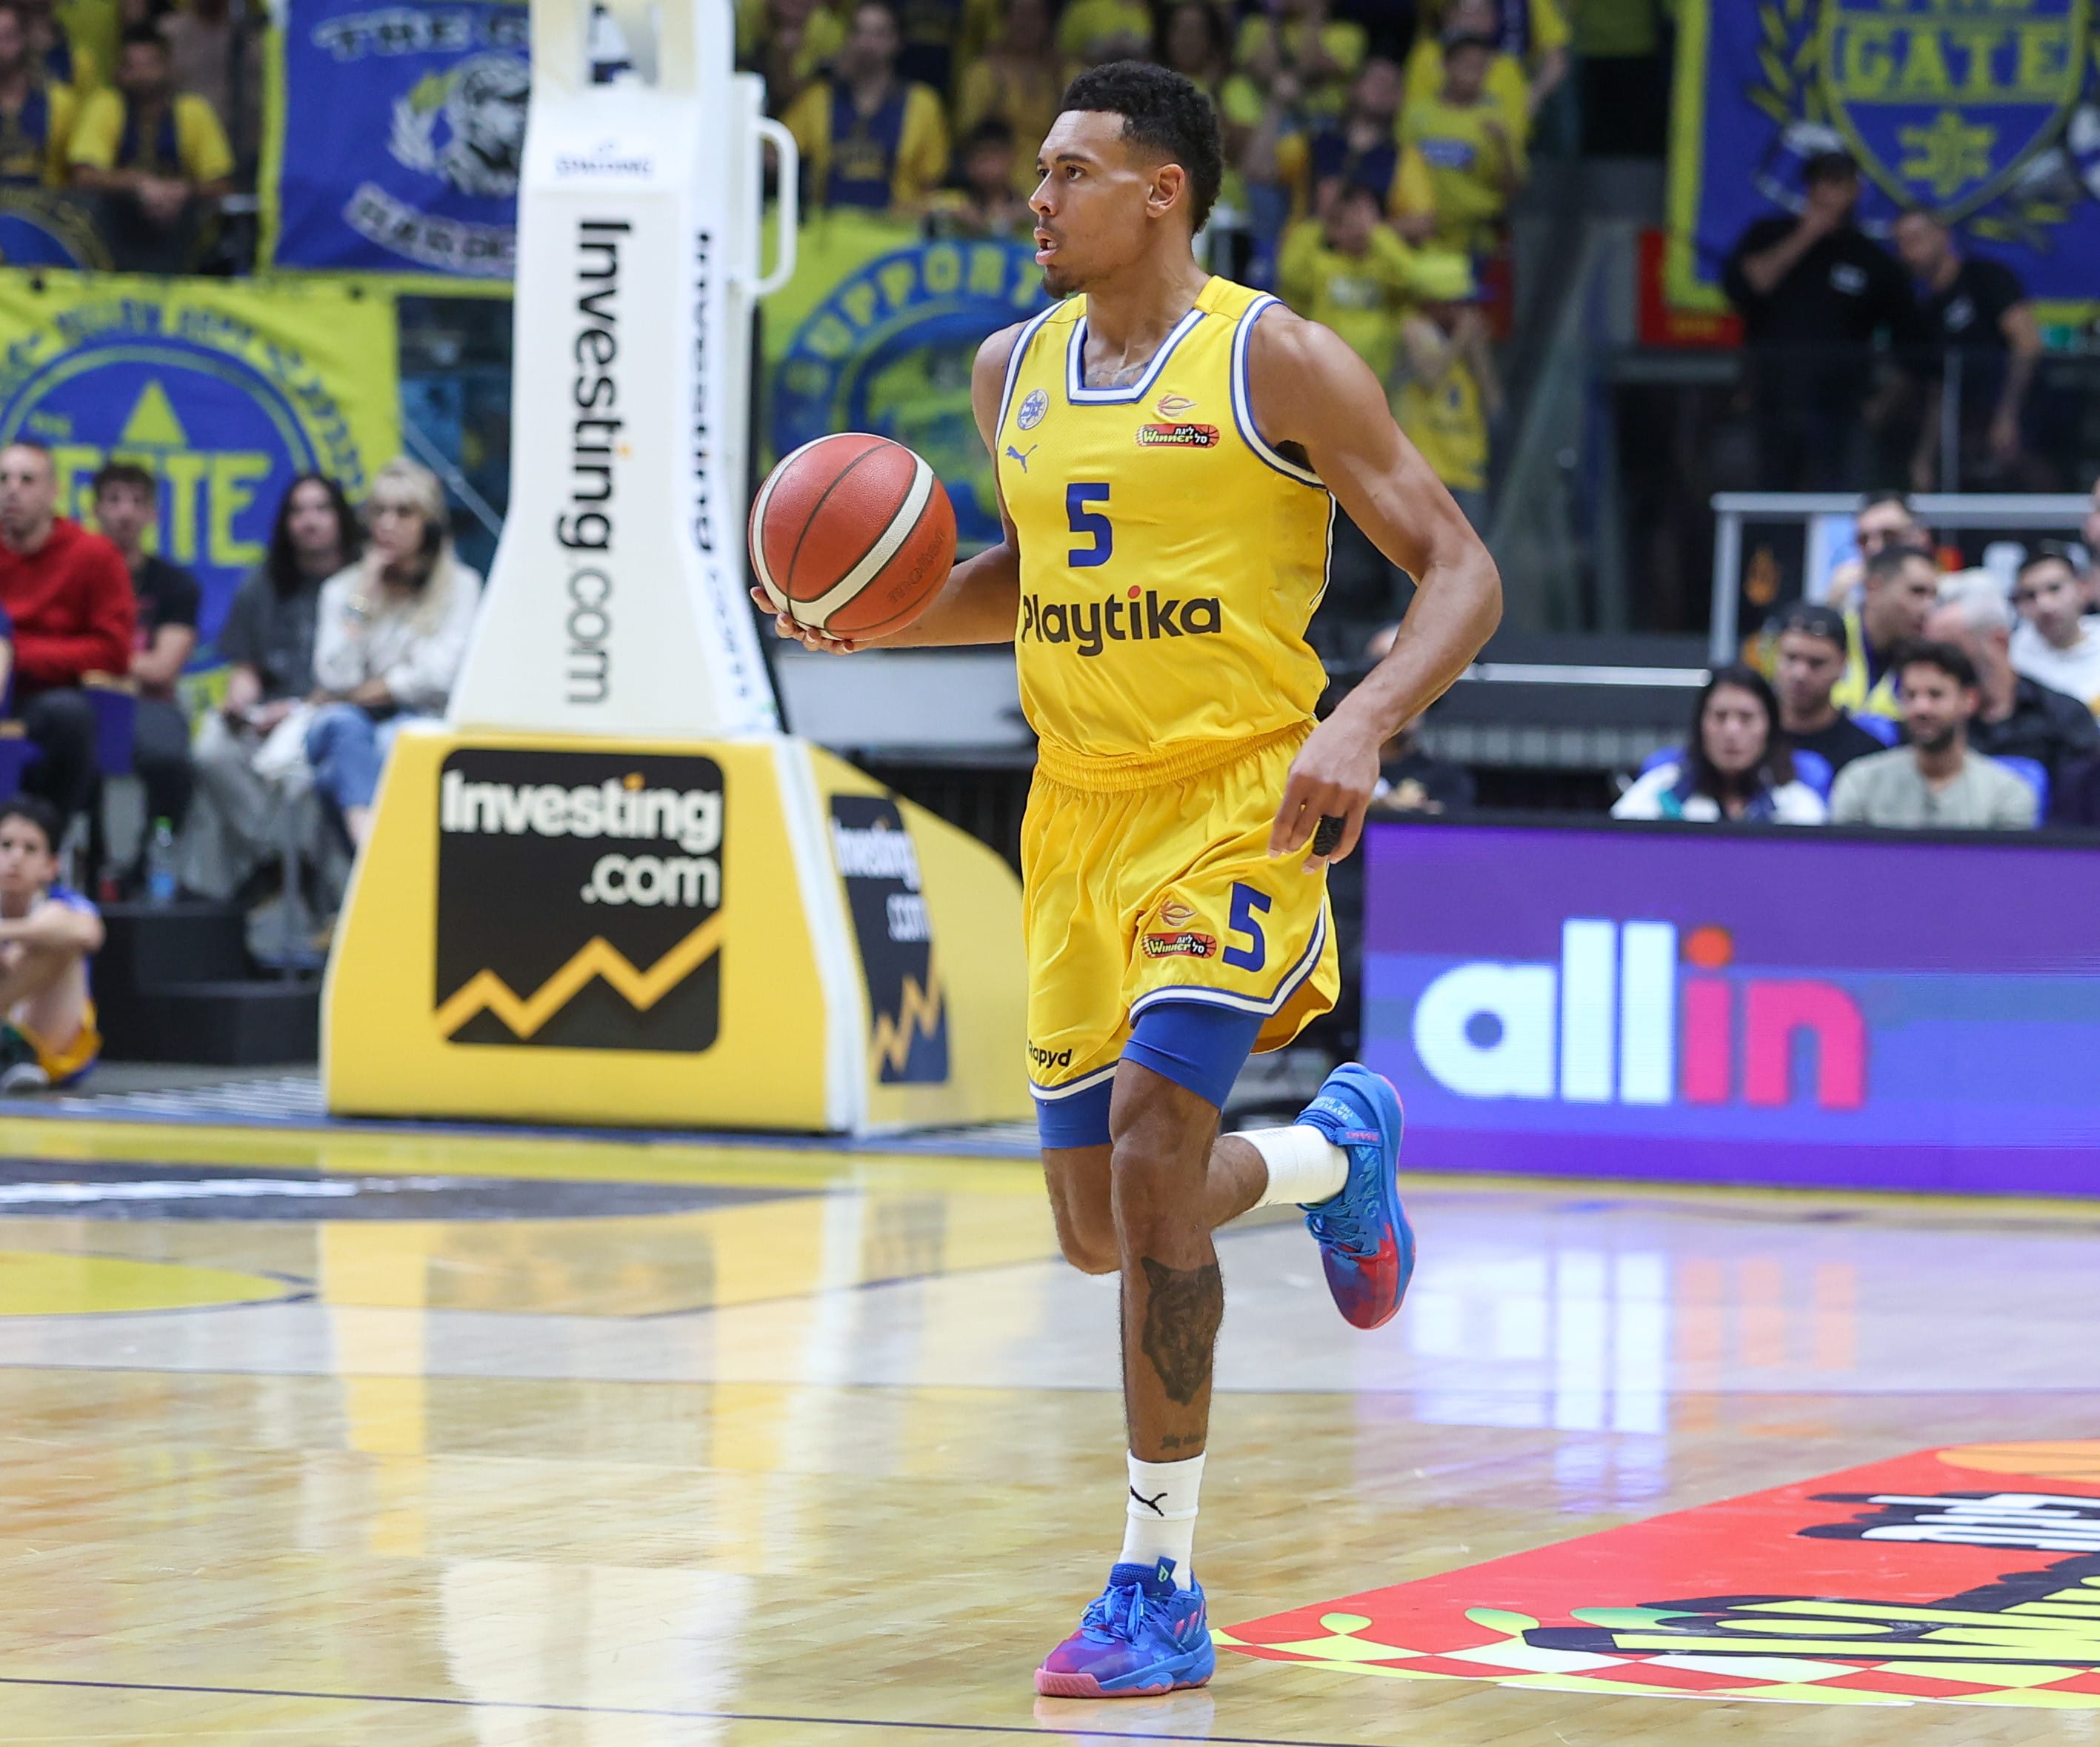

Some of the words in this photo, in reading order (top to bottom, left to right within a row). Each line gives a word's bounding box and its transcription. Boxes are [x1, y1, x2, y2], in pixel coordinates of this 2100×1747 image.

[1143, 430, 1194, 443] Winner
[52, 443, 273, 568] GTE
[1066, 482, 1112, 568] 5
[1021, 585, 1221, 657] Playtika
[441, 771, 724, 855] Investing
[580, 853, 720, 908] .com
[1150, 939, 1191, 954] Winner
[1222, 882, 1273, 973] 5
[1028, 1039, 1073, 1069] Rapyd
